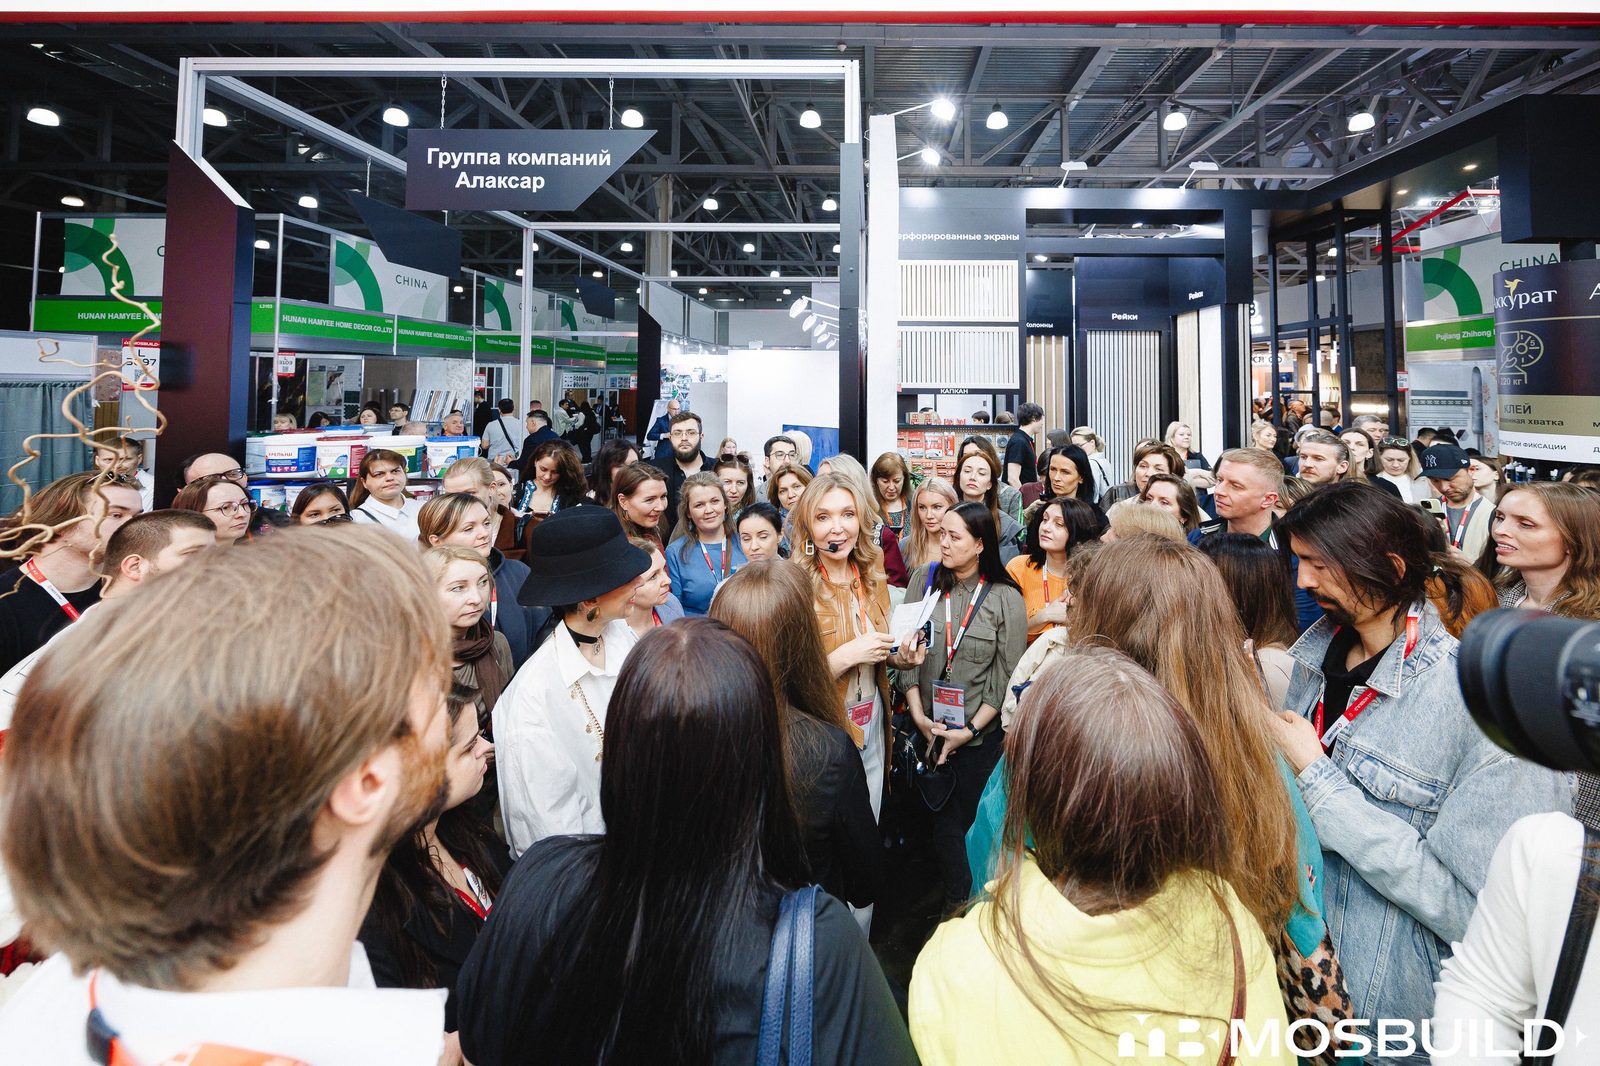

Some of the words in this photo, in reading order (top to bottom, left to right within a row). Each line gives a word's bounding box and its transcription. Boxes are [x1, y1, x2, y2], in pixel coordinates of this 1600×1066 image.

[427, 147, 501, 169] Группа
[507, 148, 611, 166] компаний
[454, 171, 545, 193] Алаксар
[897, 231, 982, 242] ерфорированные
[983, 233, 1020, 242] экраны
[1499, 252, 1558, 272] CHINA
[395, 274, 428, 290] CHINA
[1188, 290, 1204, 301] Рейки
[1494, 289, 1558, 311] ккурат
[78, 312, 106, 320] HUNAN
[107, 312, 141, 320] HAMYEE
[1111, 312, 1139, 321] Рейки
[282, 314, 307, 324] HUNAN
[307, 317, 335, 327] HAMYEE
[335, 320, 353, 329] HOME
[353, 323, 373, 331] DECOR
[398, 328, 415, 336] HUNAN
[1435, 332, 1461, 342] Pujiang
[1461, 329, 1492, 339] Zhihong
[137, 349, 146, 358] L
[1504, 402, 1532, 415] КЛЕЙ
[1527, 418, 1565, 427] хватка
[1522, 442, 1567, 451] ФИКСАЦИИ
